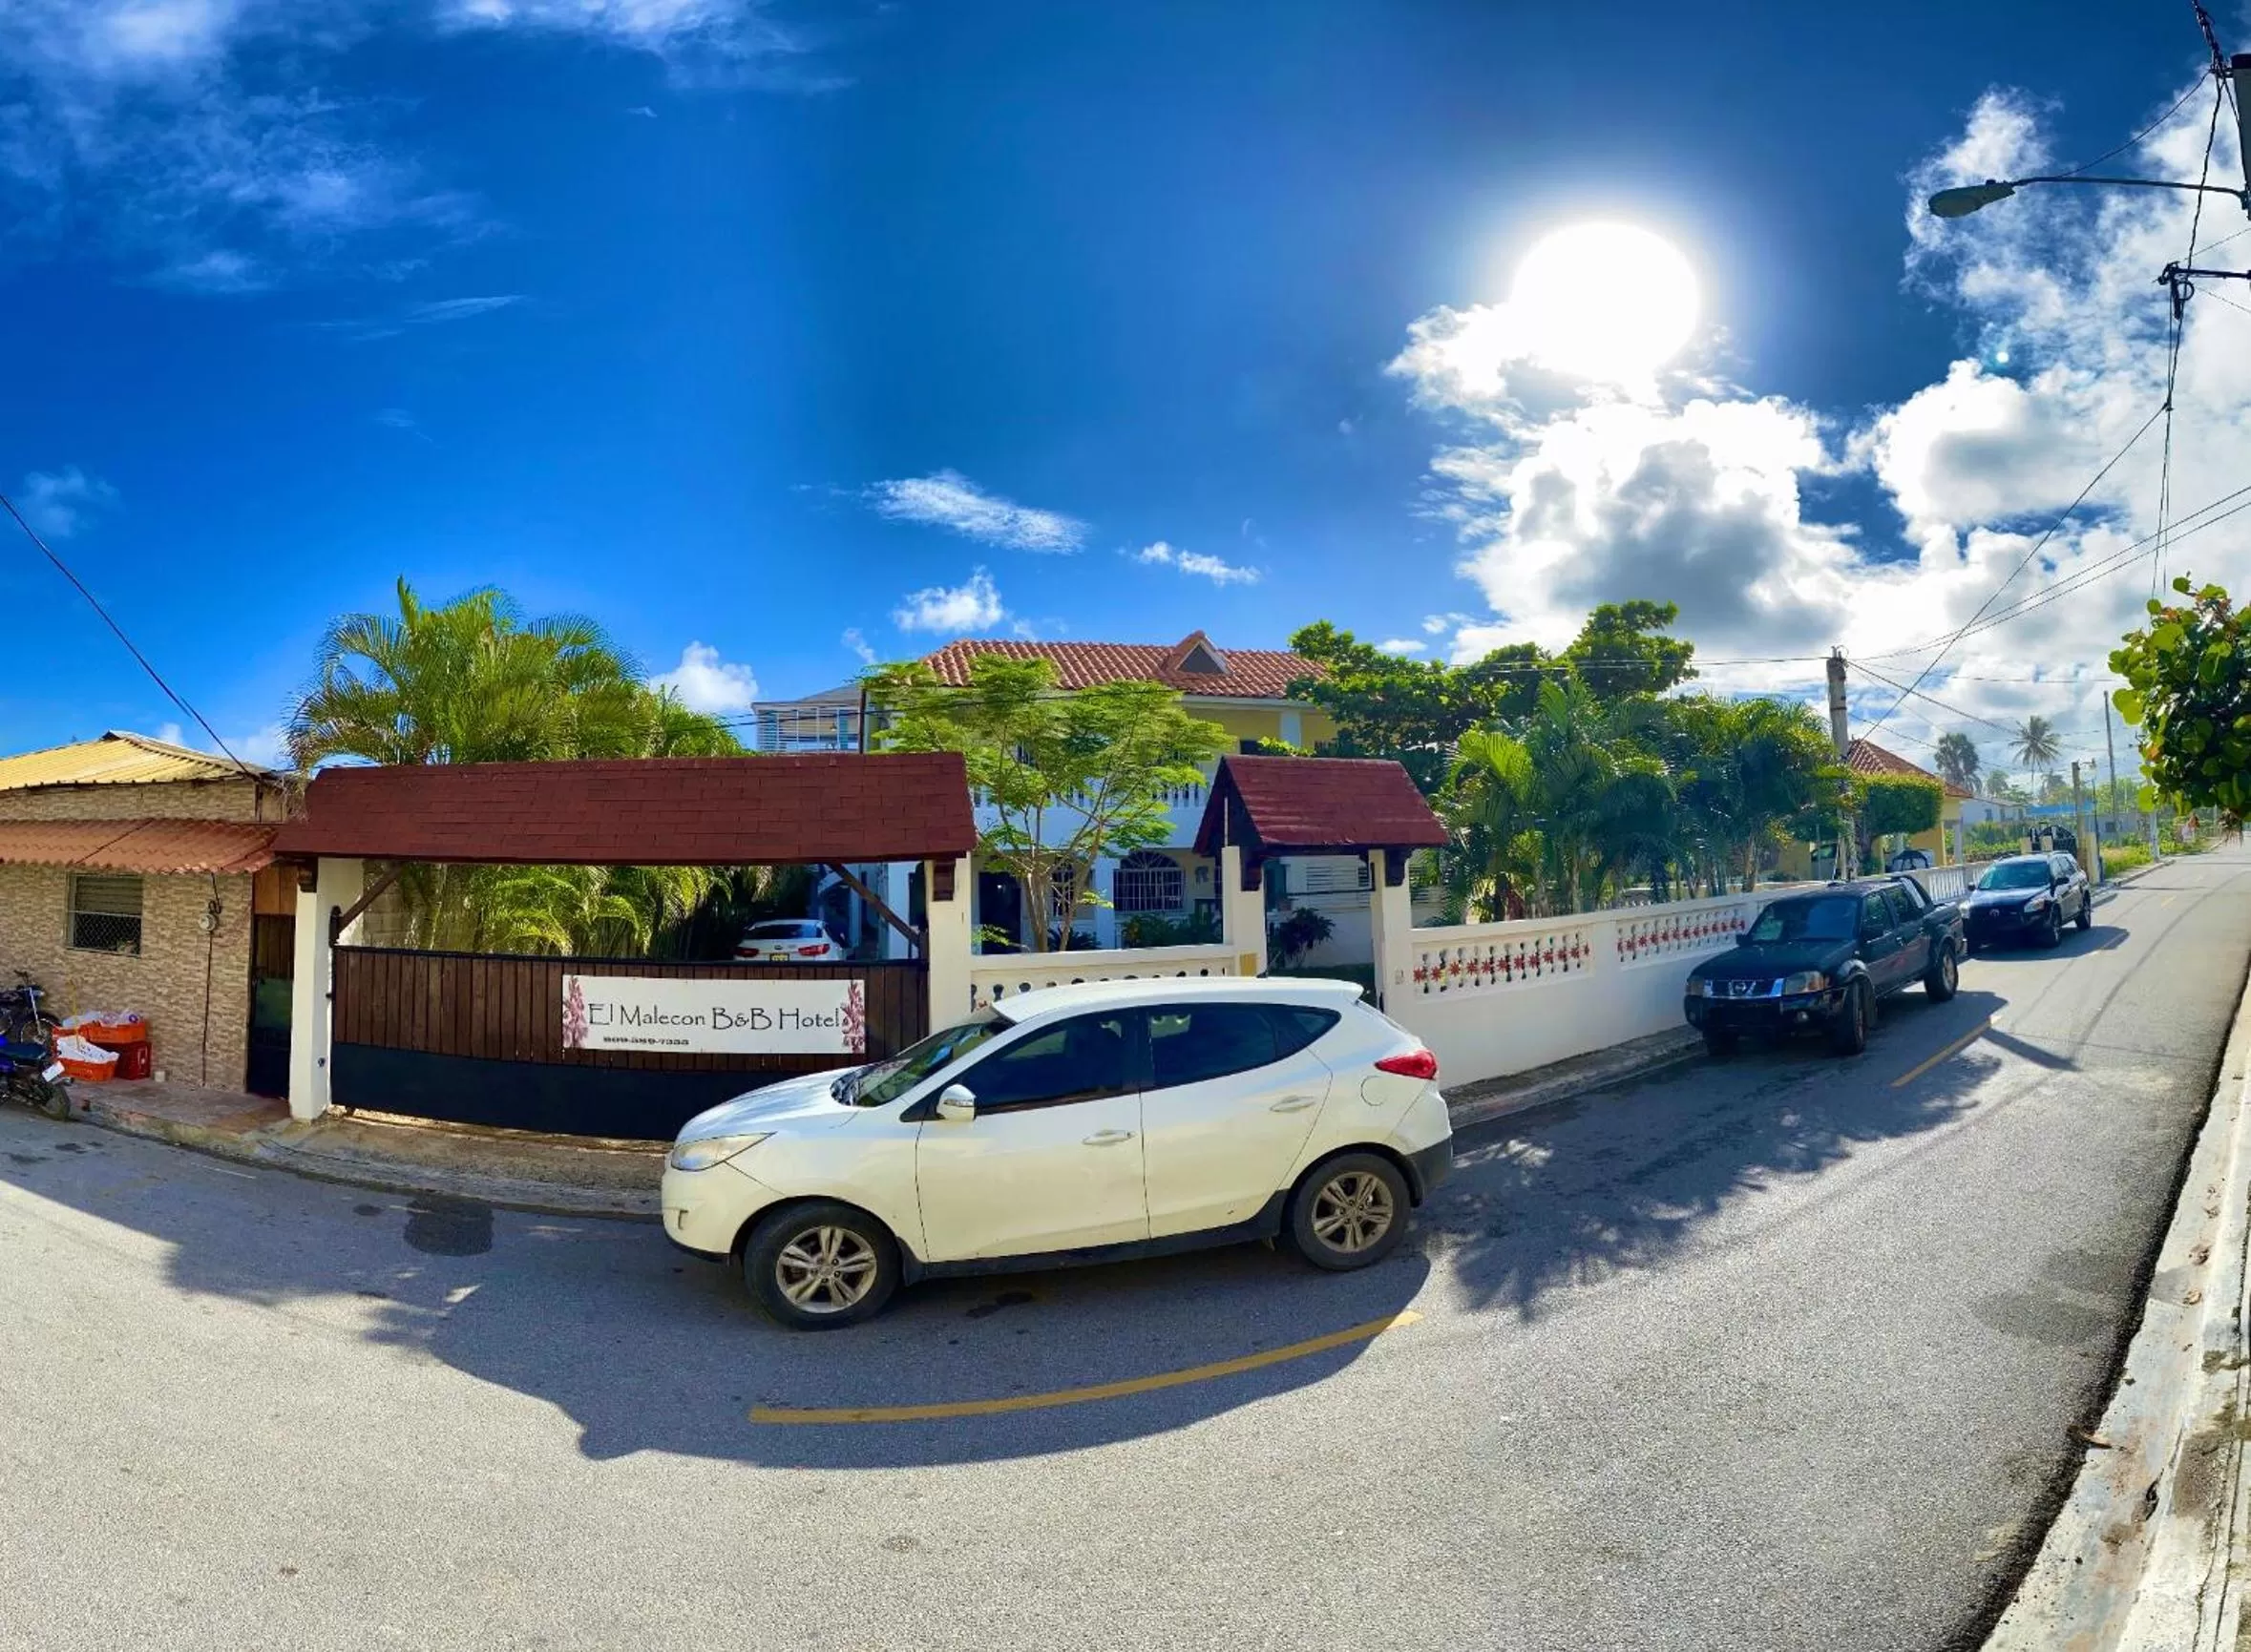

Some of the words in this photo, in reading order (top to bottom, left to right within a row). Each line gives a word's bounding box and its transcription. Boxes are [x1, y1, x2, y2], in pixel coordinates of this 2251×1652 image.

[588, 1003, 614, 1026] El
[620, 1005, 706, 1027] Malecon
[711, 1007, 772, 1031] B&B
[778, 1008, 840, 1031] Hotel
